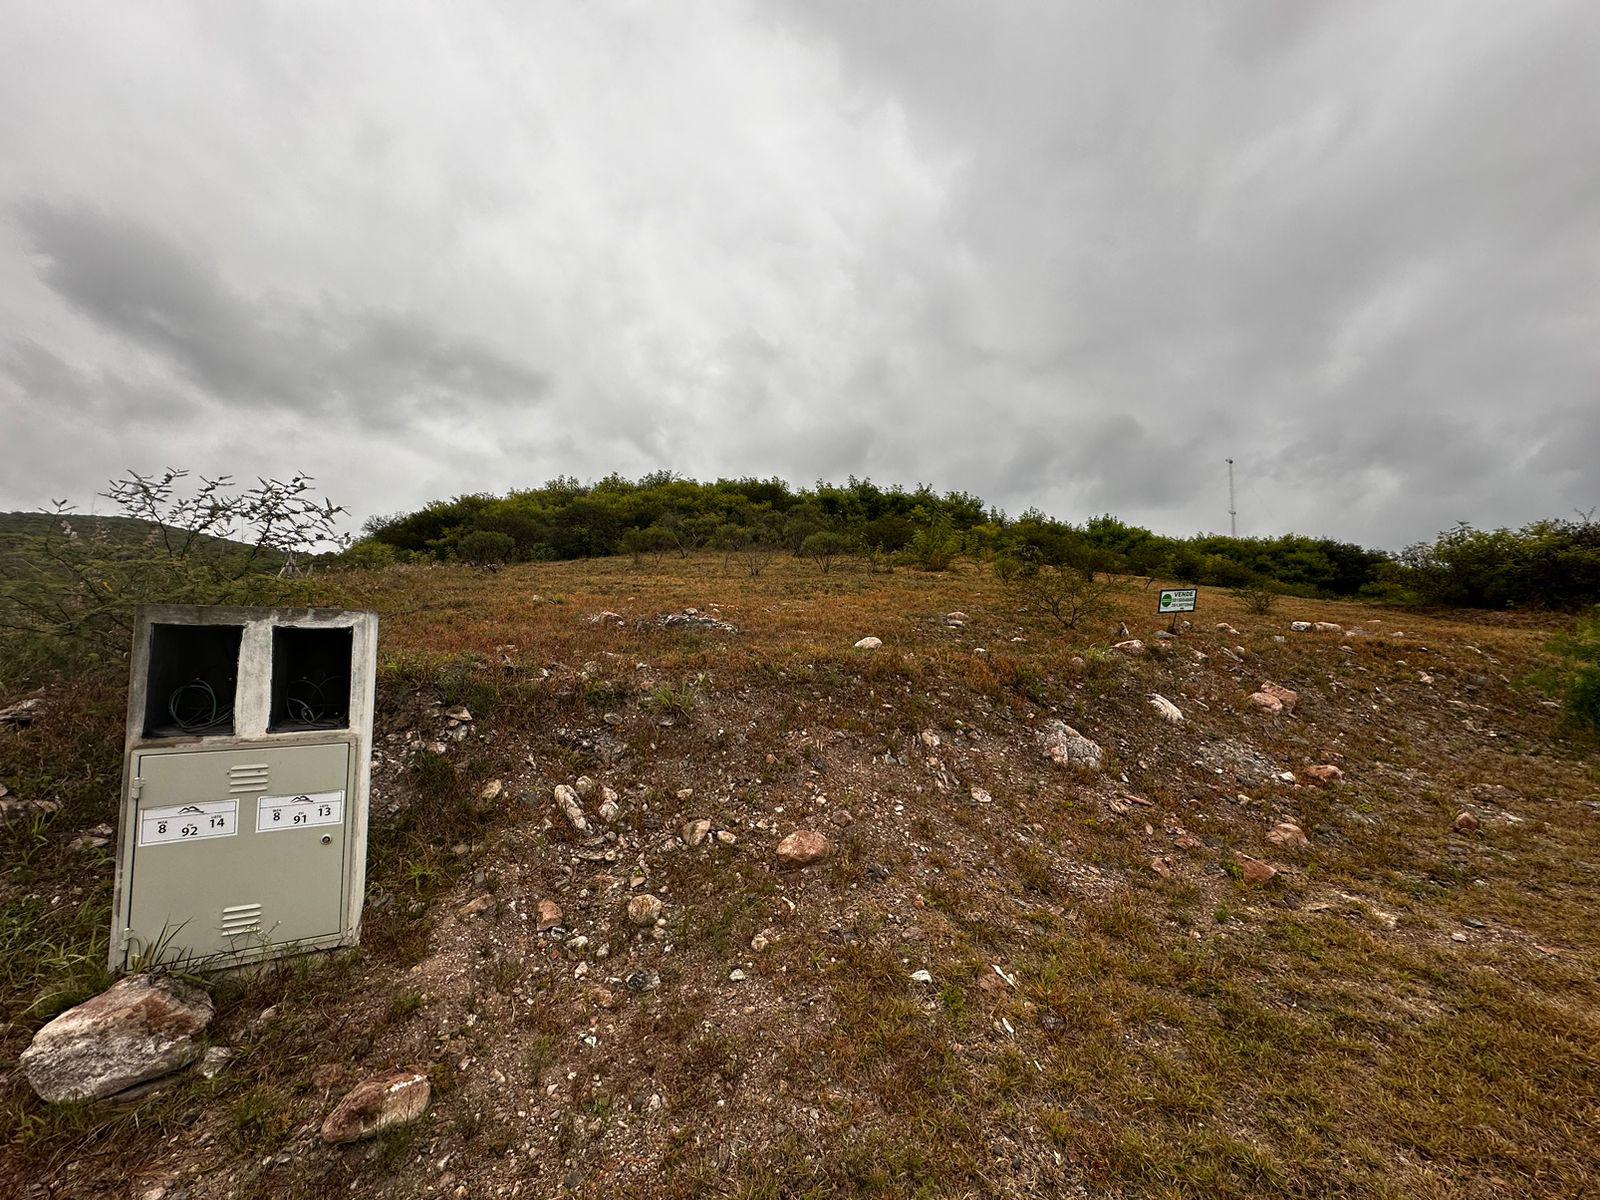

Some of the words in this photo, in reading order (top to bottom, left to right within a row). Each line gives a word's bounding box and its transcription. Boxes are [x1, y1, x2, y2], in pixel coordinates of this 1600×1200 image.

[273, 812, 280, 821] 8
[318, 807, 331, 817] 13
[209, 818, 225, 828] 14
[293, 814, 307, 824] 91
[158, 824, 167, 834] 8
[181, 826, 198, 837] 92
